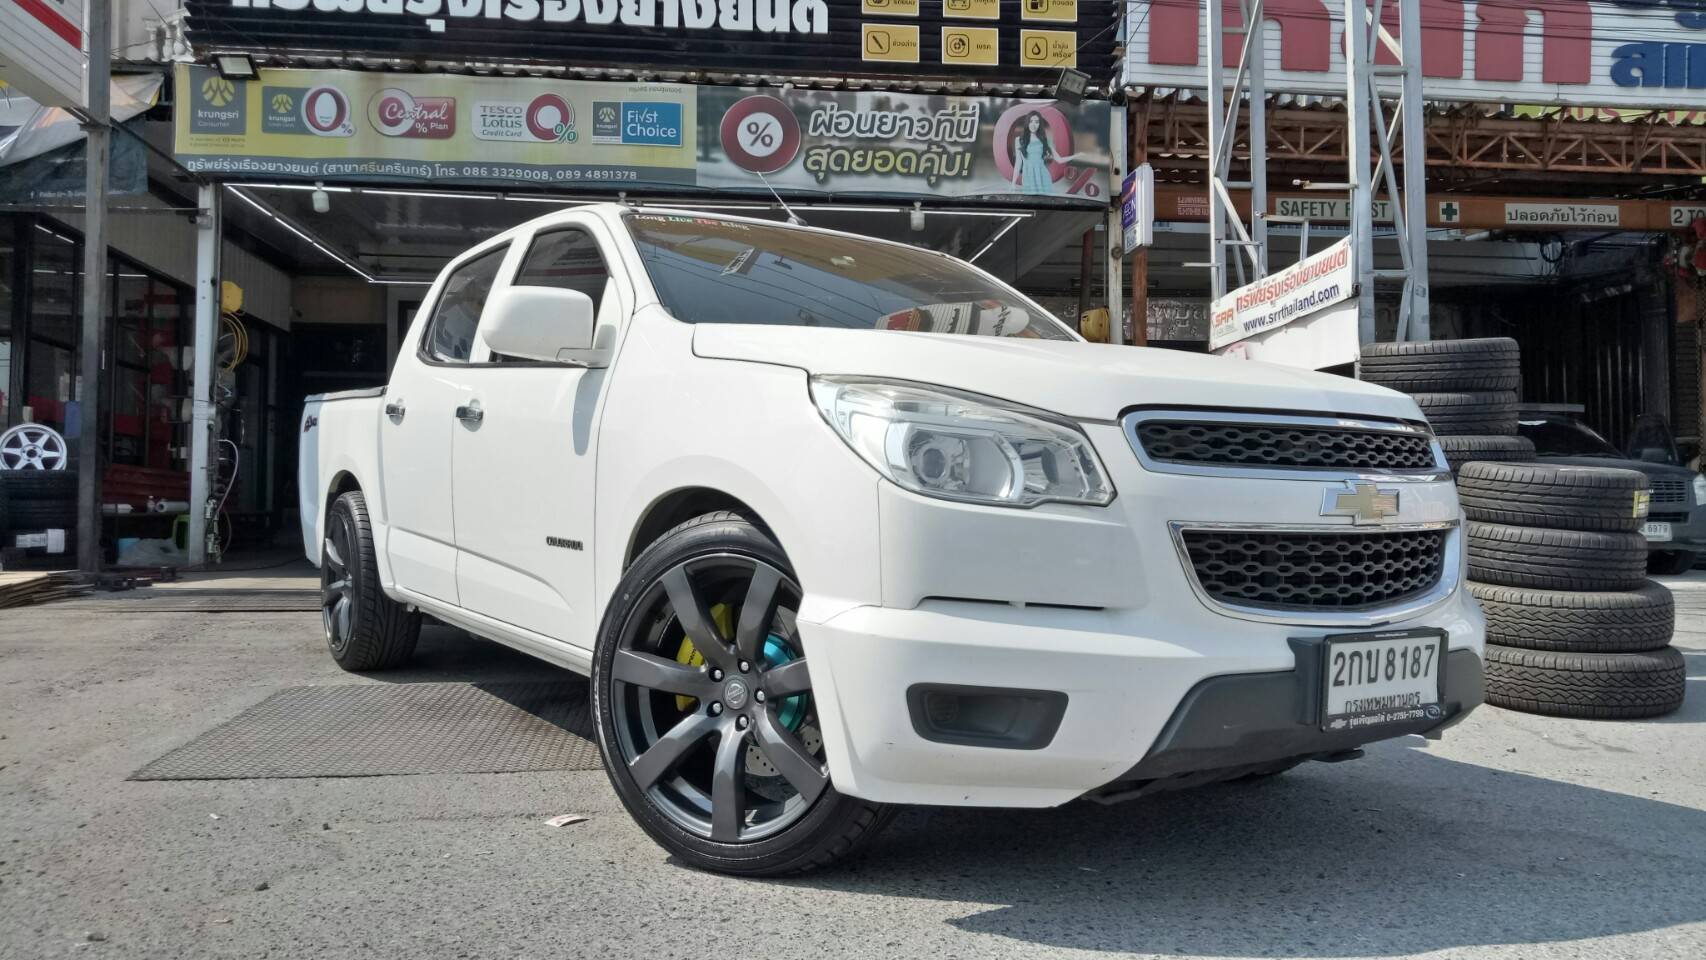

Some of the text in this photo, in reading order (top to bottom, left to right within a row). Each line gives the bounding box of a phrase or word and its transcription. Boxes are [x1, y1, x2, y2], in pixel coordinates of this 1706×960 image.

[197, 109, 239, 120] krungsri
[385, 102, 448, 120] Central
[480, 105, 522, 114] TESCO
[430, 122, 449, 130] Plan
[482, 118, 522, 128] Lotus
[626, 123, 677, 138] Choice
[810, 102, 980, 142] ผ่อนยาวที่นี่
[482, 129, 504, 137] Credit
[434, 164, 459, 176] โทร.
[462, 167, 488, 176] 086
[492, 167, 553, 181] 3329008,
[556, 170, 581, 179] 089
[585, 170, 637, 180] 4891378
[806, 146, 973, 183] สุดยอดคุ้ม!
[1280, 200, 1388, 218] SAFETY FST
[1507, 206, 1618, 224] ปลอดภัยไว้ก่อน
[1673, 208, 1683, 224] 2
[634, 214, 666, 222] Long
[1243, 284, 1340, 333] www.srrthailand.com
[1333, 644, 1436, 687] 2กบ 8187
[1345, 691, 1421, 713] กรงเทพมหานคร
